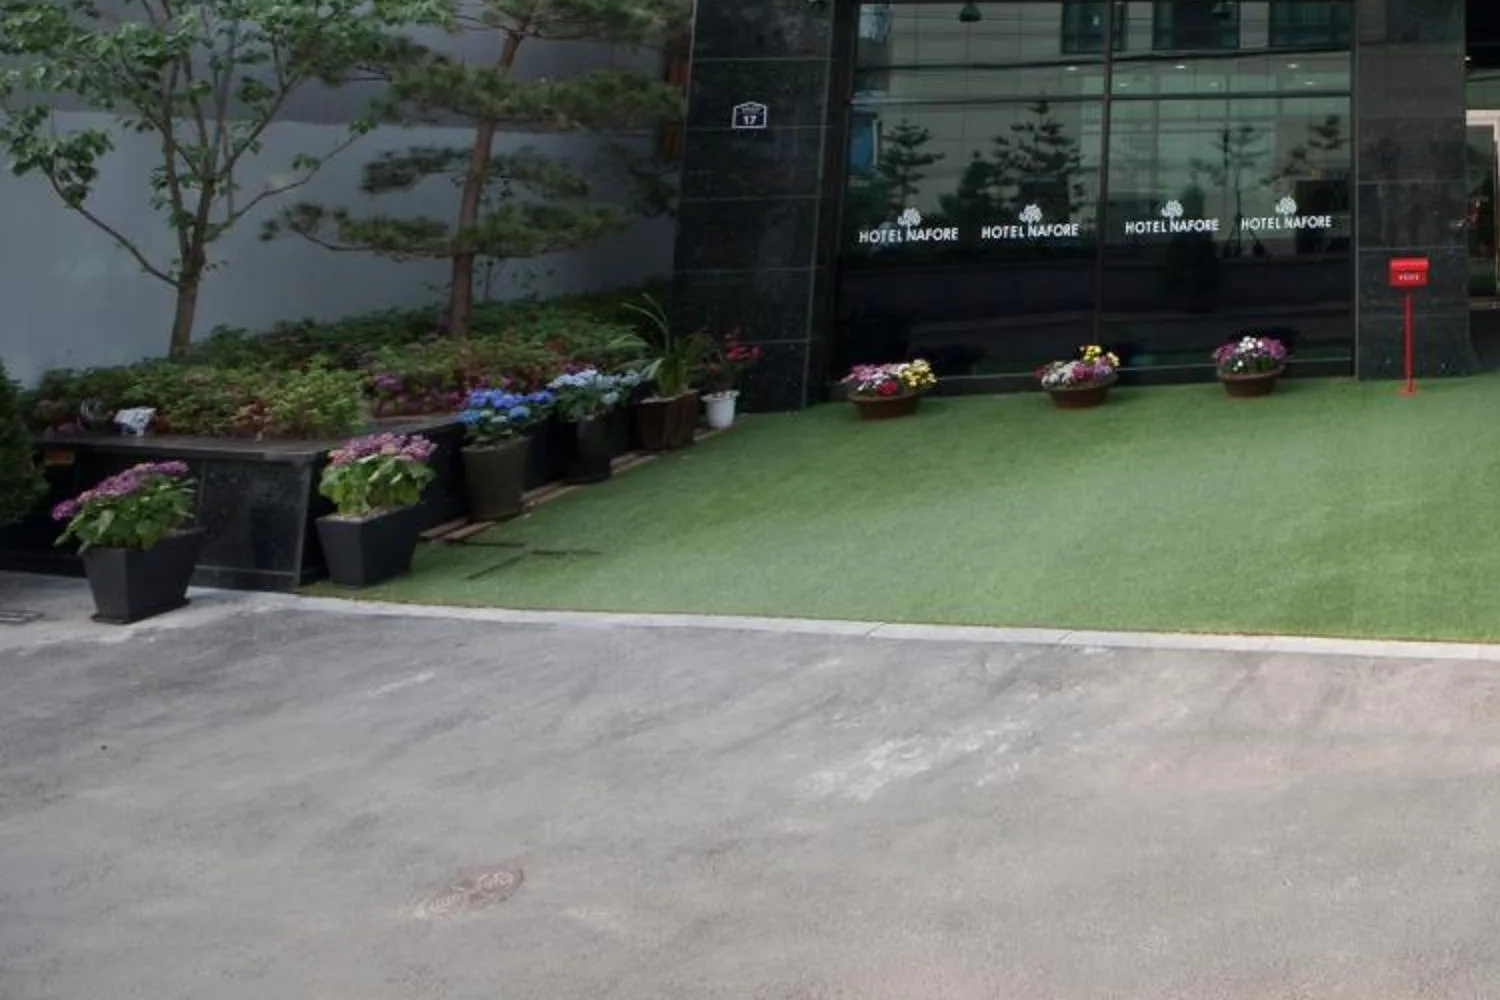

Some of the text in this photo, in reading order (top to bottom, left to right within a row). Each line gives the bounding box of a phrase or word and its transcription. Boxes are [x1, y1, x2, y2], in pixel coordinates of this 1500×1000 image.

[743, 115, 757, 125] 17
[1125, 218, 1220, 235] HOTEL NAFORE
[1241, 214, 1333, 231] HOTEL NAFORE
[859, 227, 959, 244] HOTEL NAFORE
[981, 223, 1079, 240] HOTEL NAFORE
